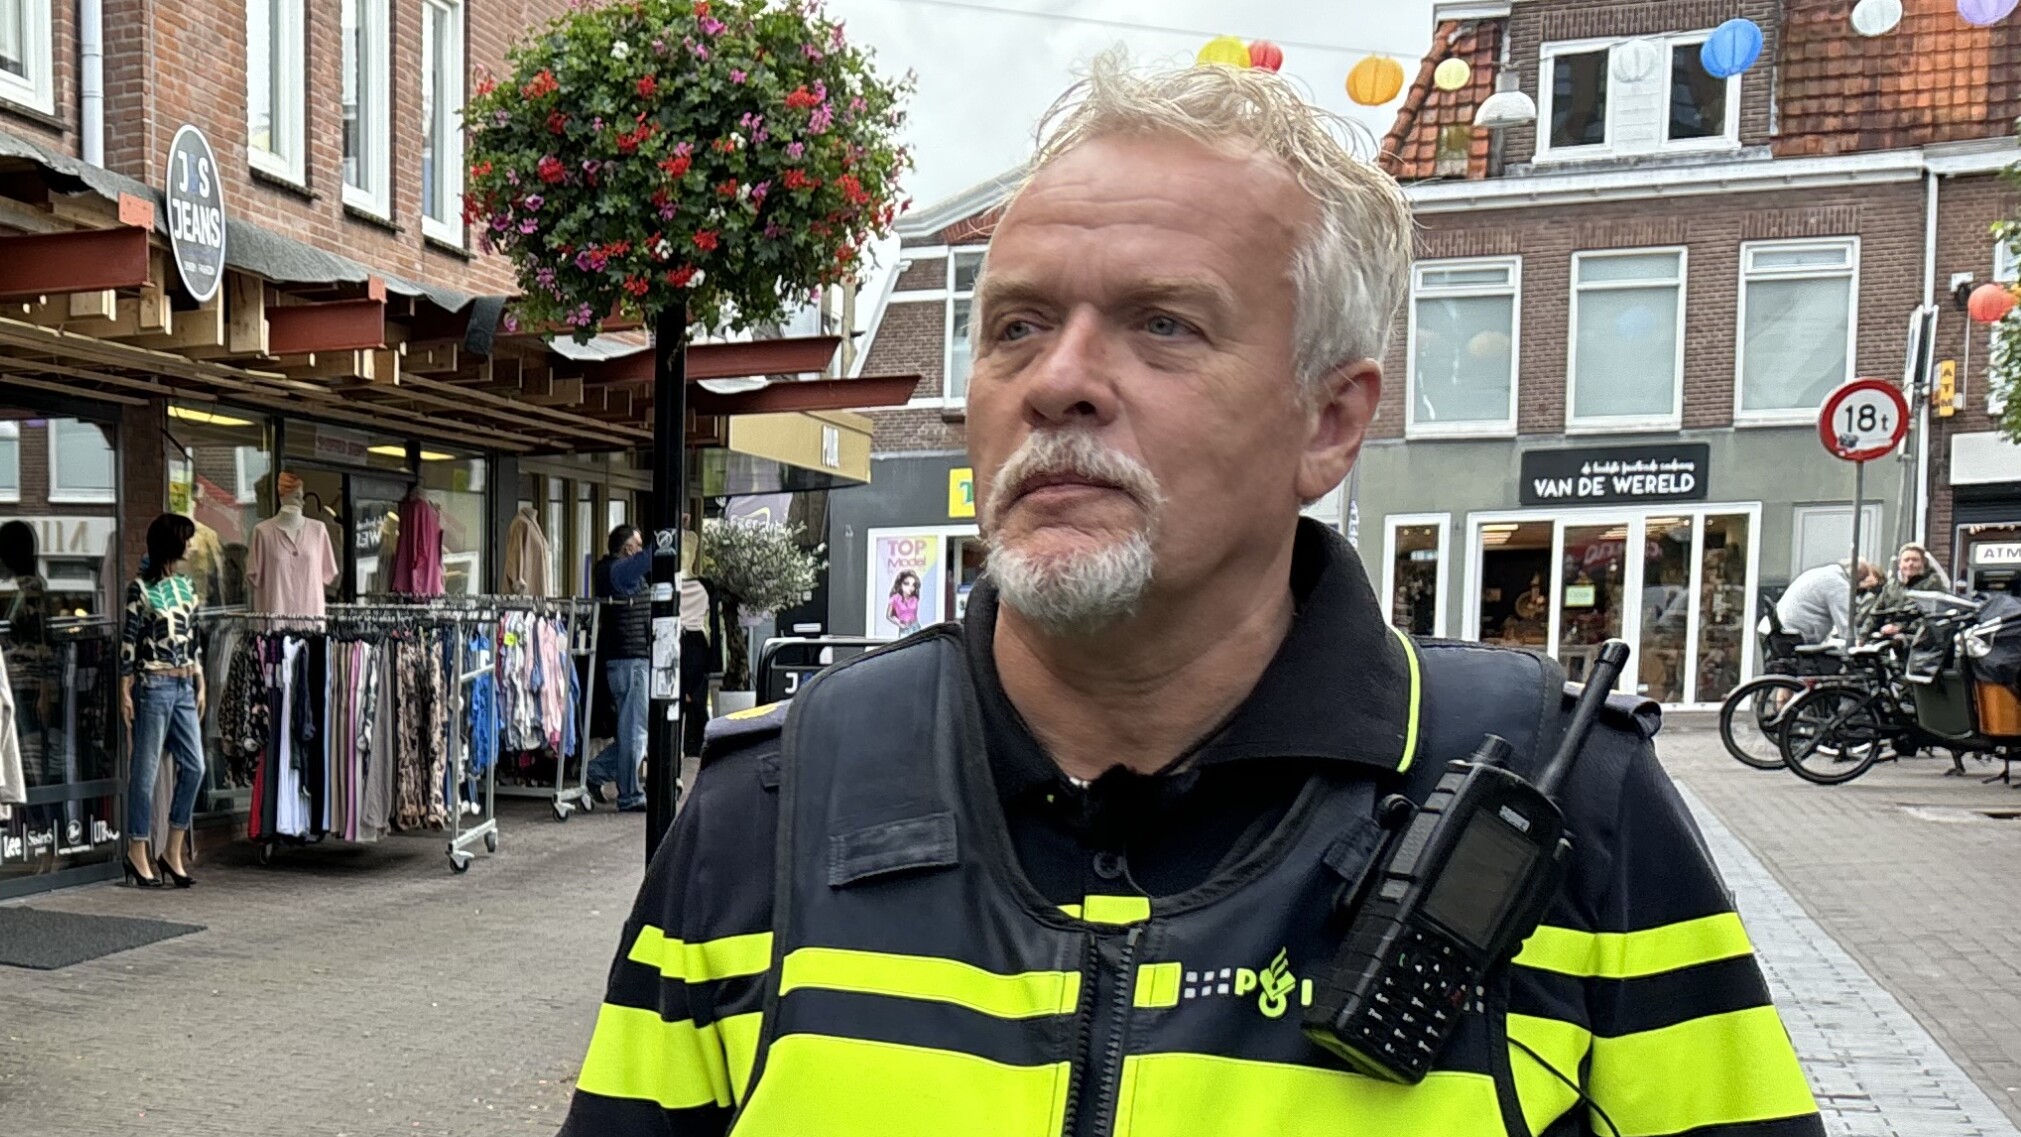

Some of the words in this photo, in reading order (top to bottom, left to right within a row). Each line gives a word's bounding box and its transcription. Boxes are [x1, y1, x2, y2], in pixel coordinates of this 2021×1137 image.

[172, 198, 222, 248] JEANS
[1941, 368, 1954, 407] ATM
[1845, 403, 1876, 432] 18
[1881, 414, 1889, 432] t
[1534, 477, 1573, 498] VAN
[1578, 476, 1606, 496] DE
[1612, 472, 1696, 495] WERELD
[888, 539, 927, 556] TOP
[1984, 547, 2021, 559] ATM
[3, 834, 22, 858] Lee
